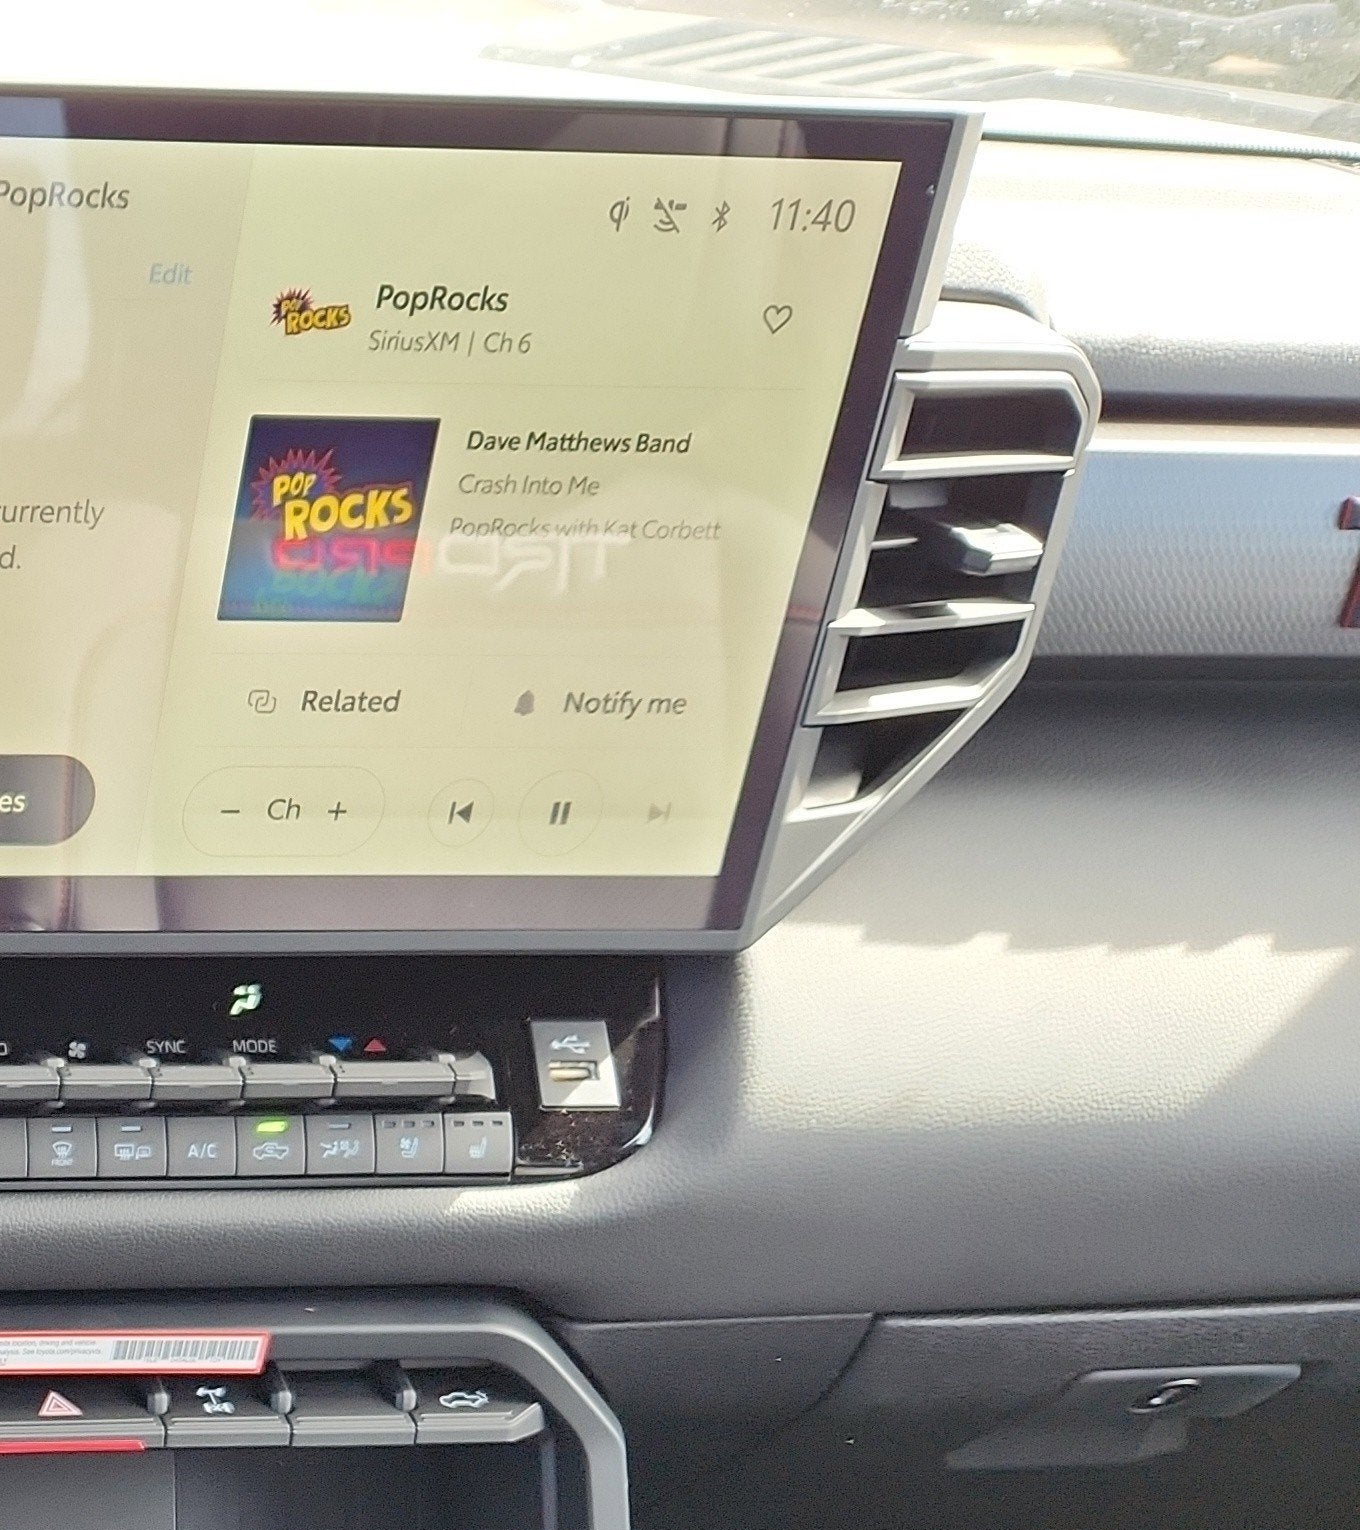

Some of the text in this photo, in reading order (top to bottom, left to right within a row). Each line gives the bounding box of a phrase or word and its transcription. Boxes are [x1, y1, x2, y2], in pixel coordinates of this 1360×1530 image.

[770, 197, 857, 233] 11:40
[148, 262, 194, 285] Edit
[375, 284, 510, 317] PopRocks
[285, 304, 351, 335] ROCKS
[368, 329, 533, 354] SiriusXM Ch 6
[466, 430, 693, 454] Dave Matthews Band
[272, 471, 317, 508] POP
[458, 473, 601, 496] Crash Into Me
[283, 487, 414, 541] ROCKS
[449, 516, 551, 539] PopRocks
[554, 518, 599, 536] with
[641, 519, 722, 540] Corbett
[300, 689, 402, 714] Related
[562, 690, 688, 720] Notify me
[266, 798, 302, 822] Ch
[146, 1039, 187, 1055] SYNC
[232, 1039, 278, 1055] MODE
[187, 1143, 218, 1160] A/C
